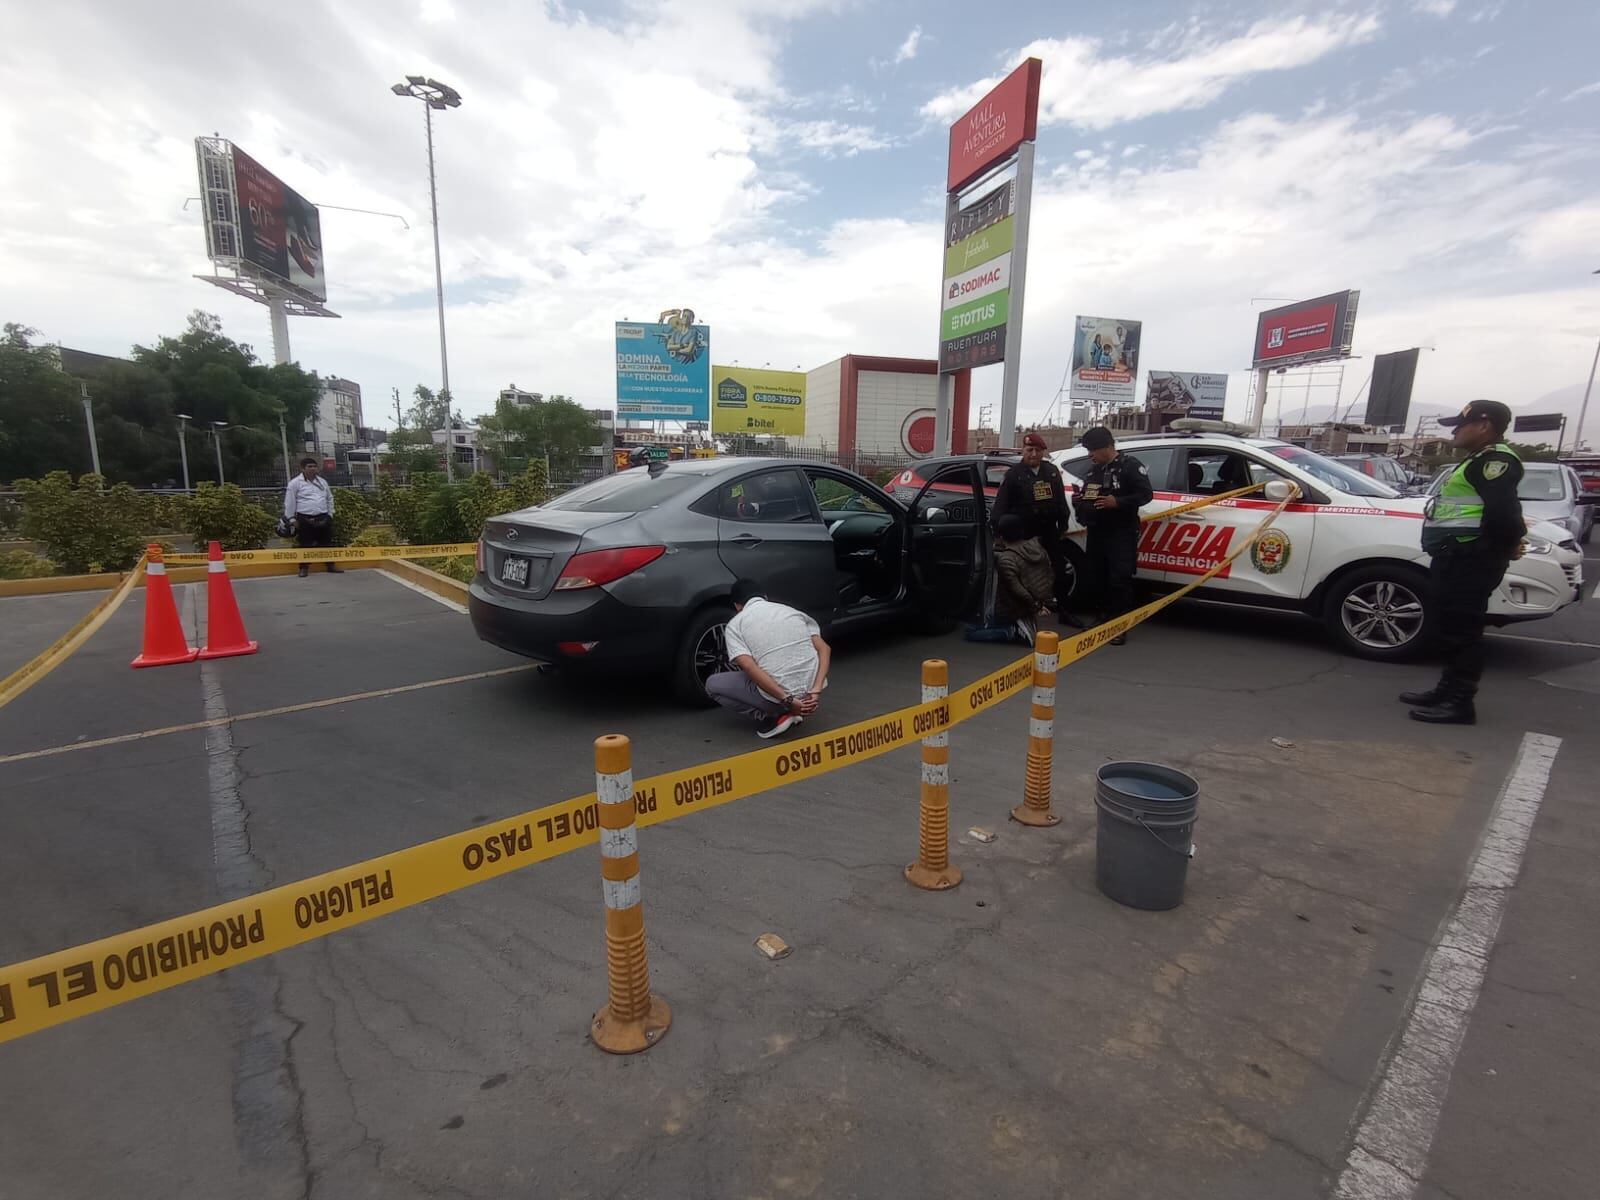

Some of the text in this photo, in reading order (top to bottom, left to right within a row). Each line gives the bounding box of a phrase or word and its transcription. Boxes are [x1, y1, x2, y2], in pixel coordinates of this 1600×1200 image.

[968, 102, 994, 137] MALL
[962, 111, 1007, 158] AVENTURA
[951, 192, 1006, 241] RIPLEY
[960, 268, 1001, 295] SODIMAC
[960, 303, 996, 327] TOTTUS
[947, 330, 997, 351] AVENTURA
[618, 353, 661, 363] DOMINA
[633, 372, 688, 382] TECNOLOGÍA
[754, 419, 775, 428] bitel
[1317, 506, 1386, 515] EMERGENCIA
[1136, 520, 1236, 558] LICIA
[1138, 553, 1220, 569] MERGENCIA
[1075, 633, 1097, 655] PASO
[969, 681, 993, 710] PASO
[994, 675, 1005, 694] EL
[775, 703, 949, 777] PELIGRO PROHIBIDO EL PASO
[673, 768, 733, 806] PELIGRO
[537, 813, 571, 843] EL
[462, 823, 532, 872] PASO
[294, 869, 394, 929] PELIGRO
[102, 907, 265, 990] PROHIBIDO
[27, 960, 98, 1009] EL
